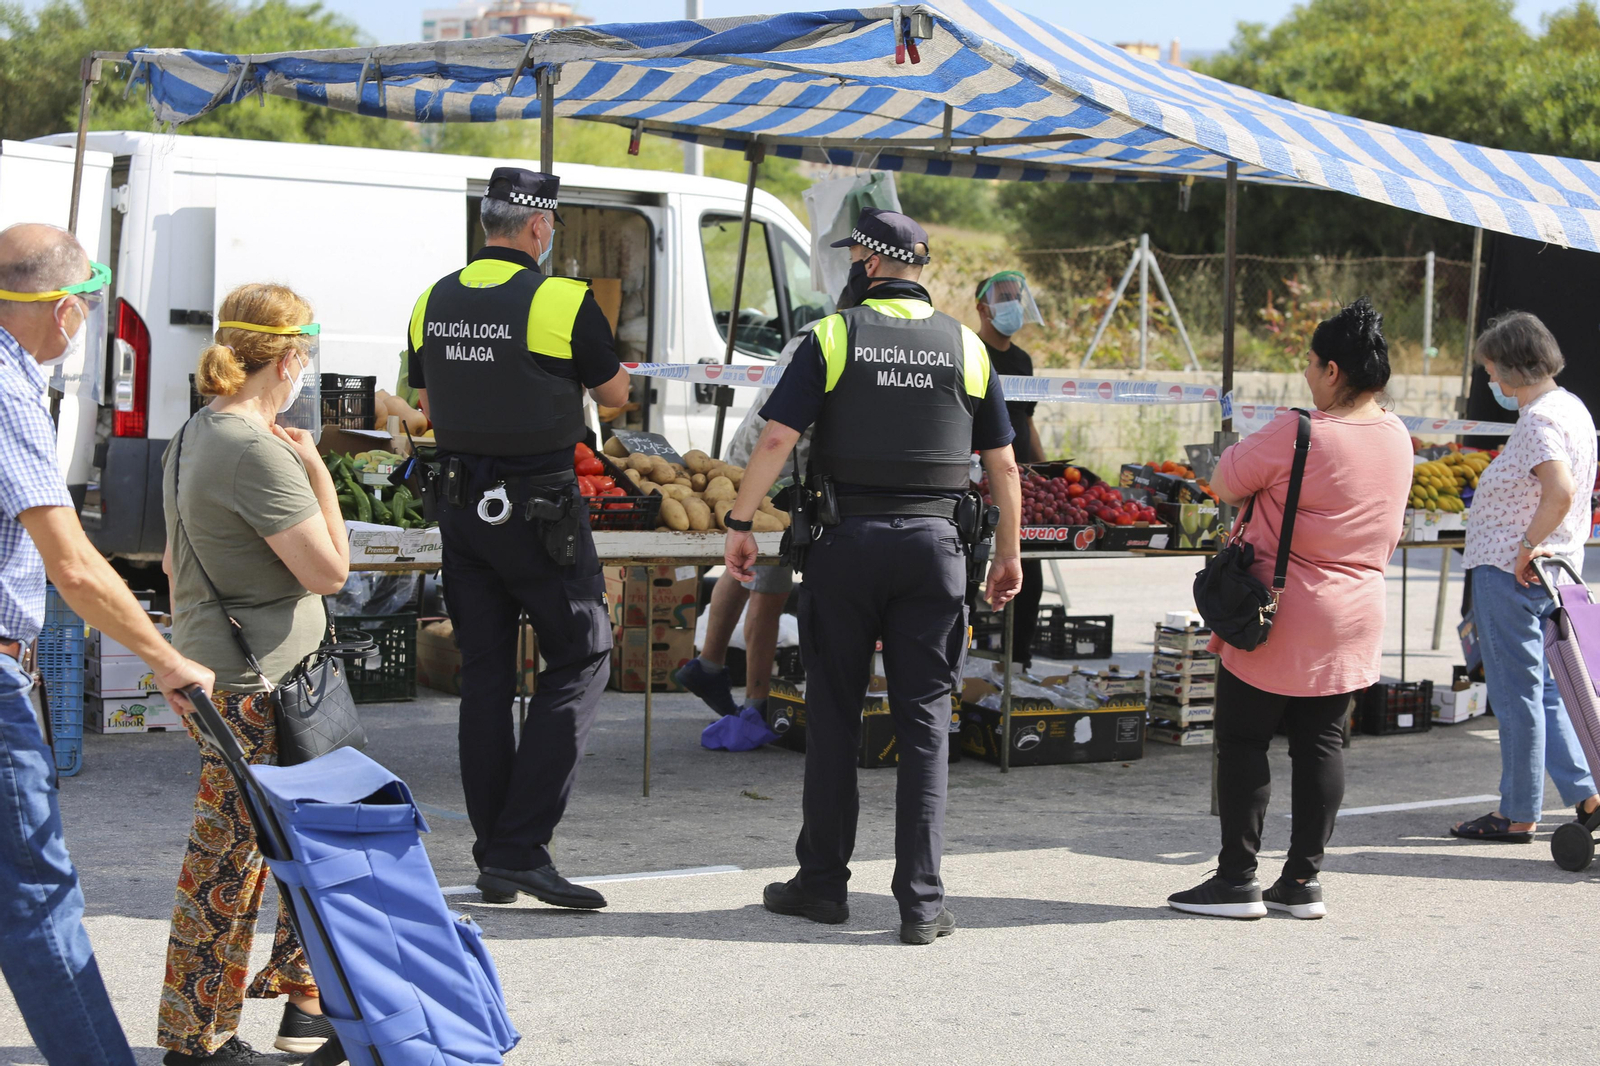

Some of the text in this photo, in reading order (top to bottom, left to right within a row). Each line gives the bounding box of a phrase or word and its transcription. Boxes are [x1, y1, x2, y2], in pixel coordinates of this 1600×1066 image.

[427, 320, 512, 339] POLICÍA LOCAL
[445, 342, 494, 362] MÁLAGA
[854, 345, 954, 367] POLICÍA LOCAL
[877, 368, 934, 389] MÁLAGA
